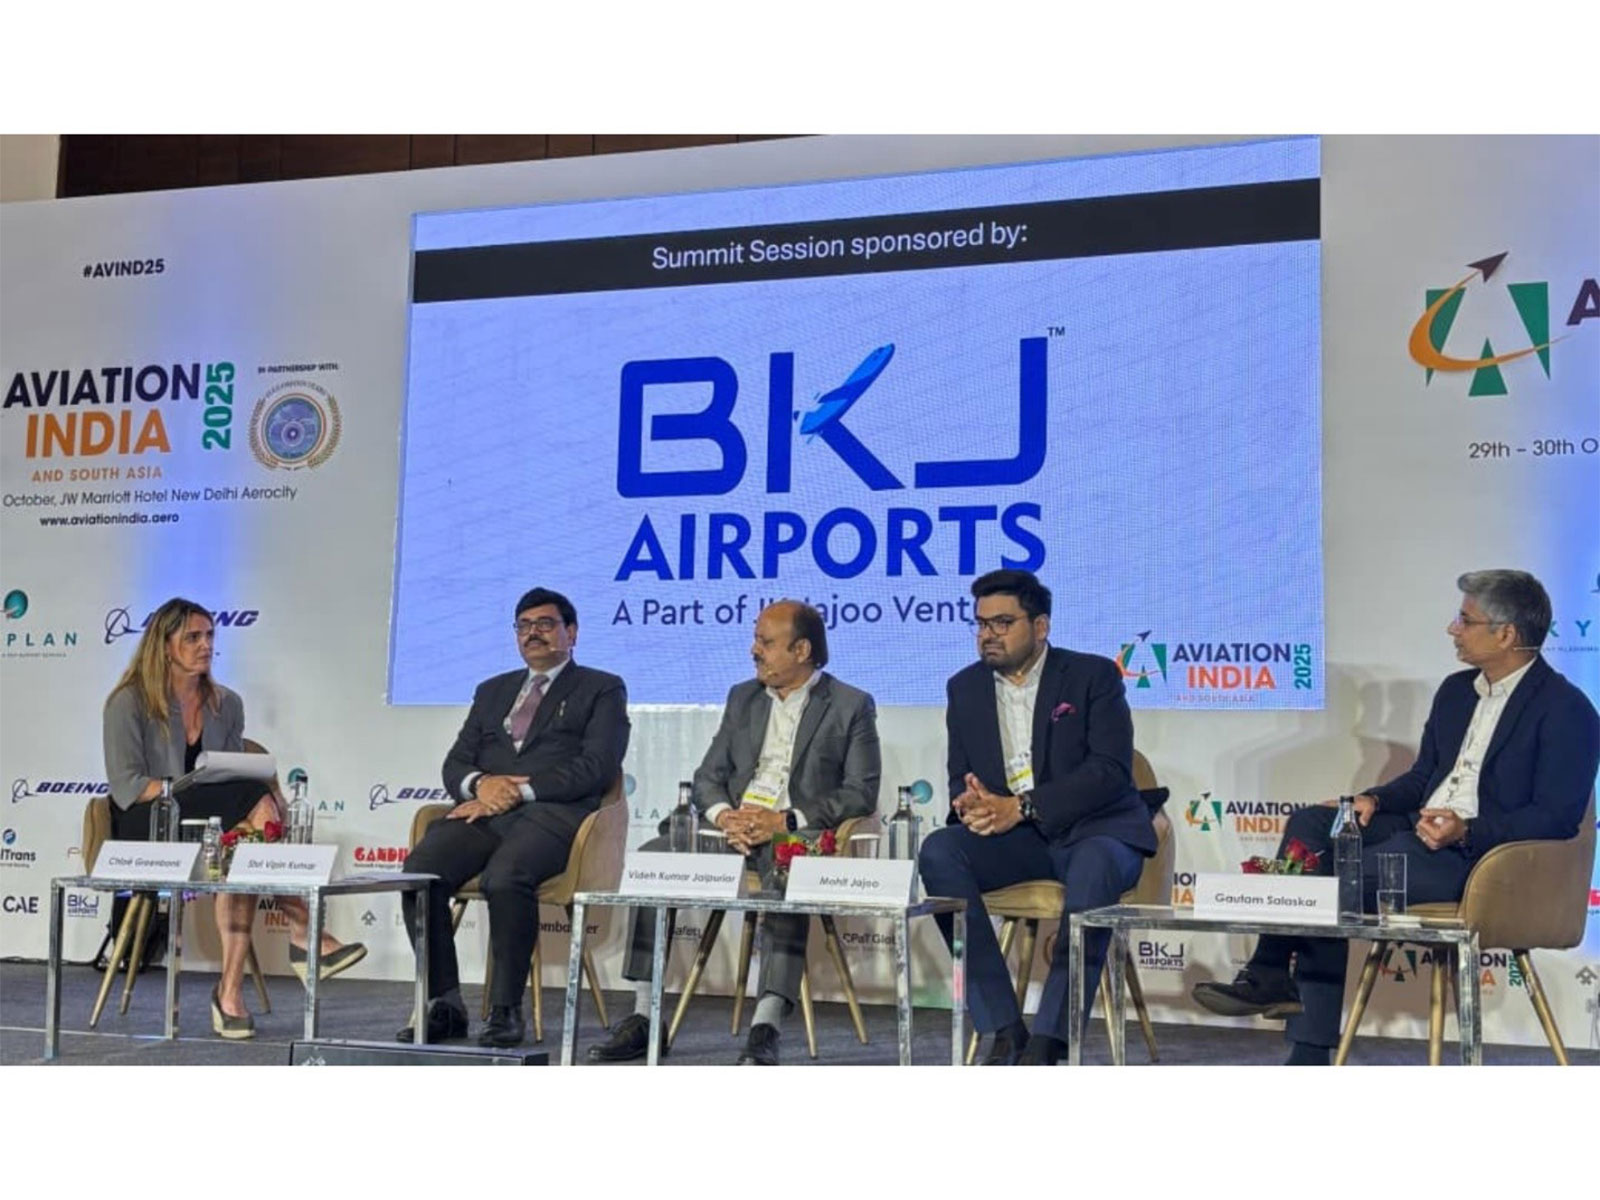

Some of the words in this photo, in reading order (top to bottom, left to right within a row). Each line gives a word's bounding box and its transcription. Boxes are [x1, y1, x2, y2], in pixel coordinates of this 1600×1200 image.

[651, 240, 744, 271] Summit
[749, 236, 845, 265] Session
[849, 223, 984, 258] sponsored
[988, 220, 1028, 250] by:
[82, 259, 165, 278] #AVIND25
[3, 363, 200, 408] AVIATION
[202, 361, 235, 450] 2025
[616, 337, 1049, 499] BKJ
[25, 408, 171, 459] INDIA
[1468, 442, 1510, 459] 29th
[1532, 439, 1574, 456] 30th
[32, 470, 63, 483] AND
[70, 468, 119, 481] SOUTH
[126, 466, 162, 479] ASIA
[3, 492, 57, 507] October,
[60, 490, 79, 505] JW
[81, 489, 131, 504] Marriott
[135, 488, 168, 502] Hotel
[172, 487, 200, 501] New
[204, 486, 238, 500] Delhi
[242, 485, 297, 502] Aerocity
[40, 512, 179, 526] www.aviationindia.aero
[614, 502, 1047, 582] AIRPORTS
[612, 600, 633, 625] A
[643, 598, 704, 624] Part
[714, 594, 748, 624] of
[804, 594, 882, 630] ajoo
[893, 595, 977, 624] Vent
[1172, 643, 1291, 663] AVIATION
[1294, 643, 1312, 690] 2025
[1187, 665, 1276, 690] INDIA
[36, 782, 109, 794] BOEING
[397, 788, 451, 800] BOEI
[1235, 817, 1281, 833] INDI
[3, 896, 38, 913] CAE
[1215, 893, 1264, 904] Gautam
[1267, 896, 1316, 907] Salaskar
[1138, 942, 1184, 957] BKJ
